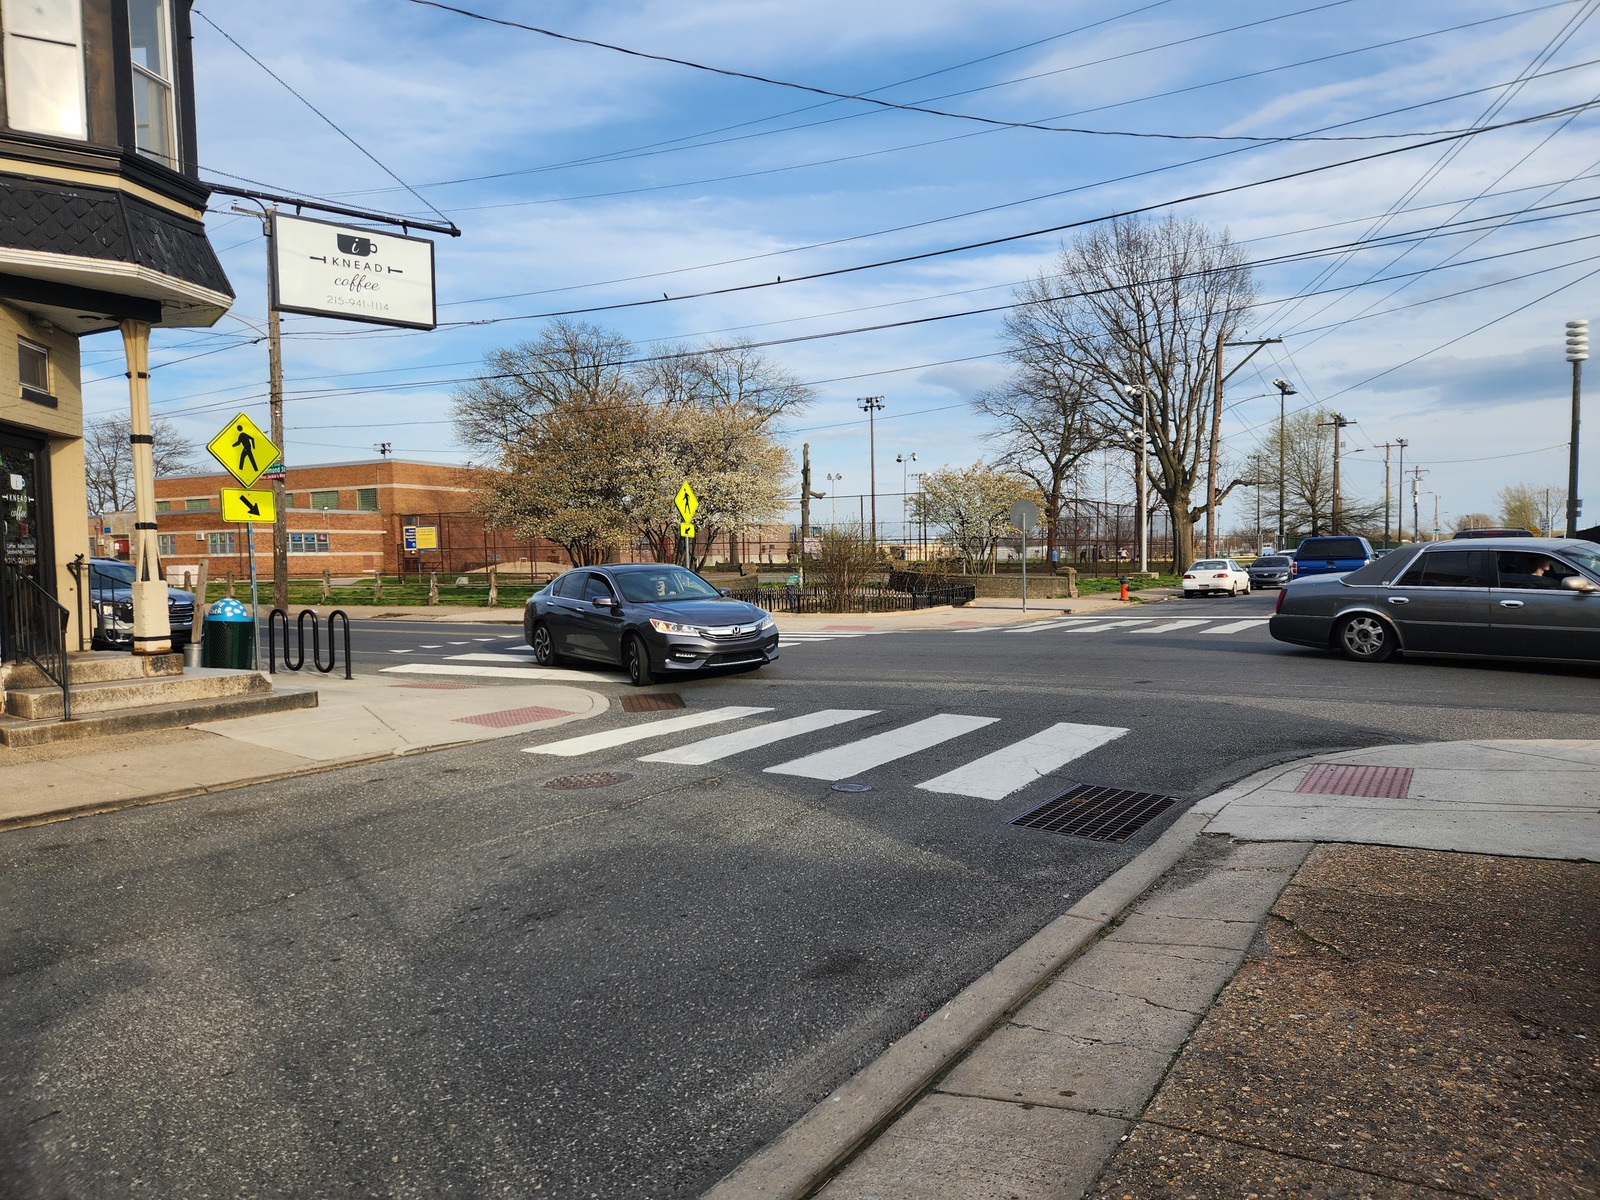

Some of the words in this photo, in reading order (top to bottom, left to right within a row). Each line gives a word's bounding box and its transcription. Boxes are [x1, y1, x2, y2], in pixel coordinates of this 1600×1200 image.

[332, 257, 383, 273] KNEAD
[334, 273, 380, 292] coffee
[326, 295, 389, 311] 215-941-1114
[9, 494, 27, 503] KNEAD
[10, 506, 27, 521] coffee
